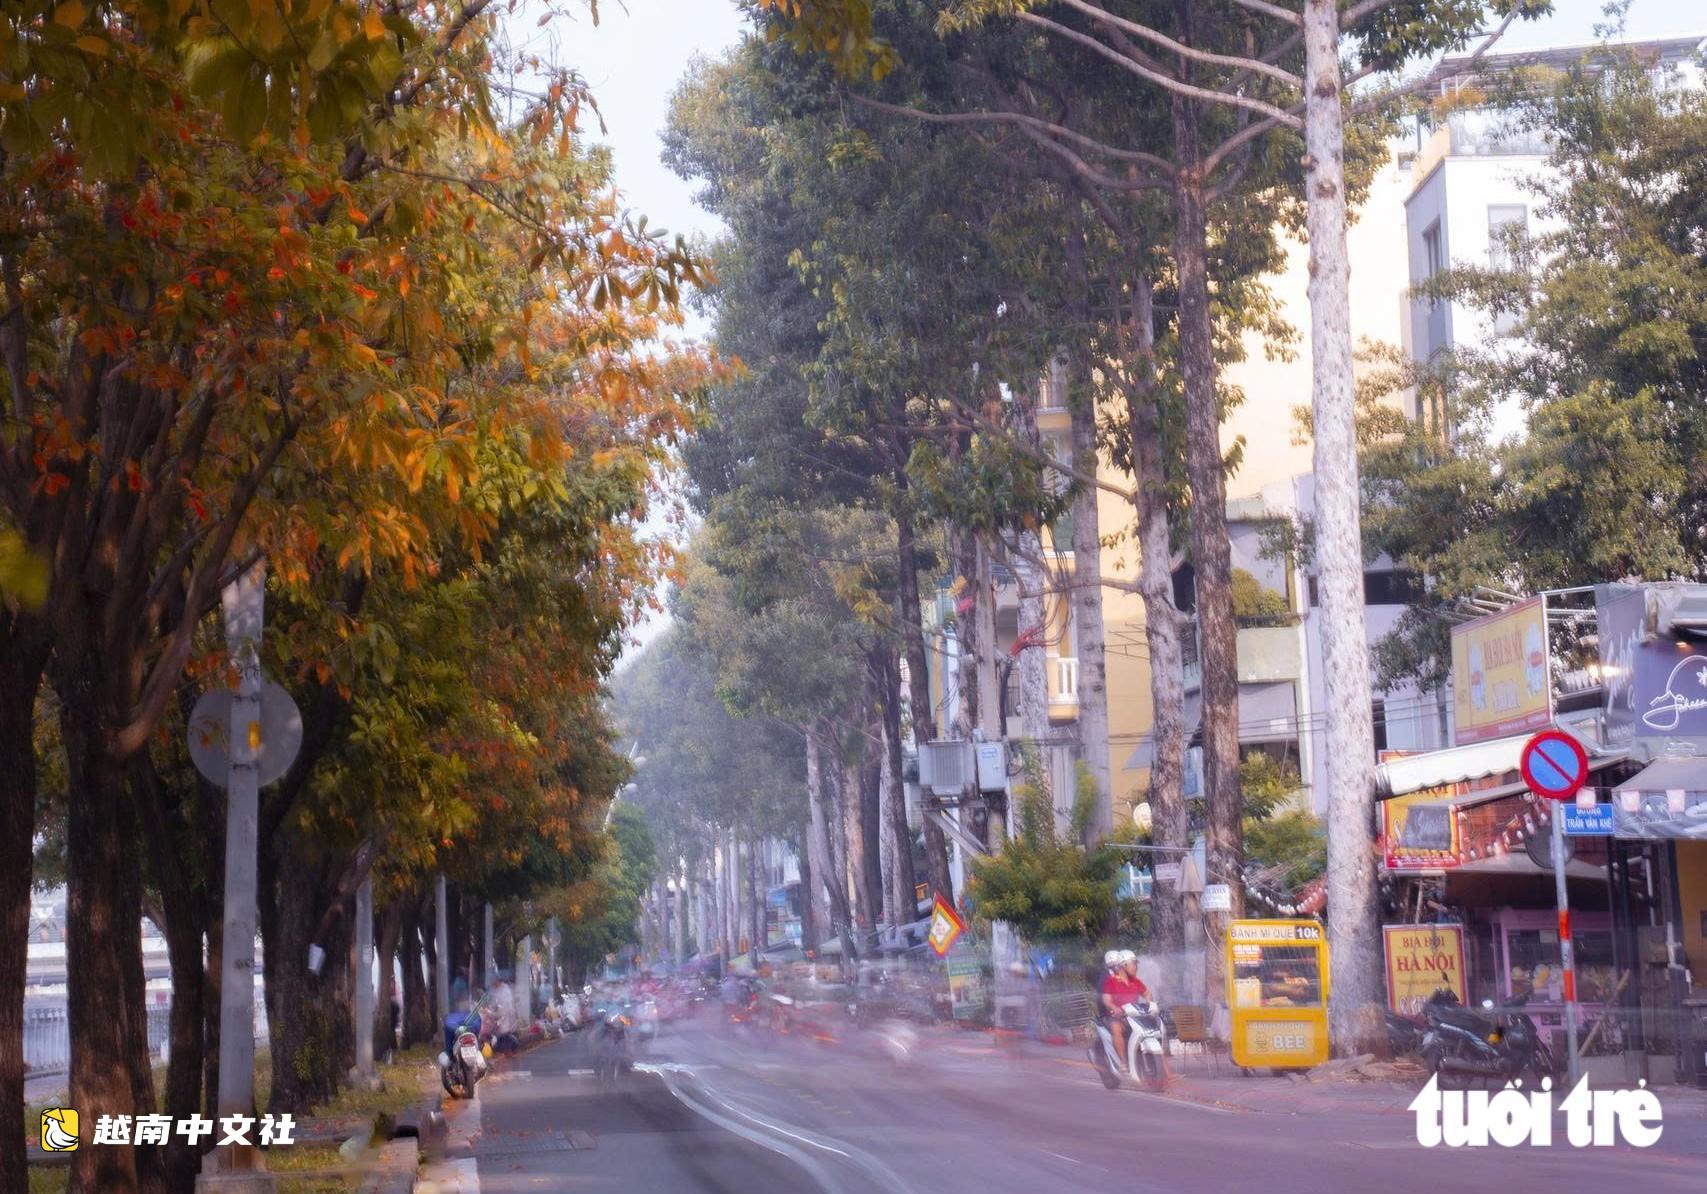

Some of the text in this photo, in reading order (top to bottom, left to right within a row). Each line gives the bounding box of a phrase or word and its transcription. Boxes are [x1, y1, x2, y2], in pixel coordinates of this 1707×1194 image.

[1297, 927, 1319, 938] 10k
[1402, 936, 1421, 948] BIA
[1396, 951, 1455, 971] HÀ NỘI
[1273, 1033, 1305, 1050] BEE
